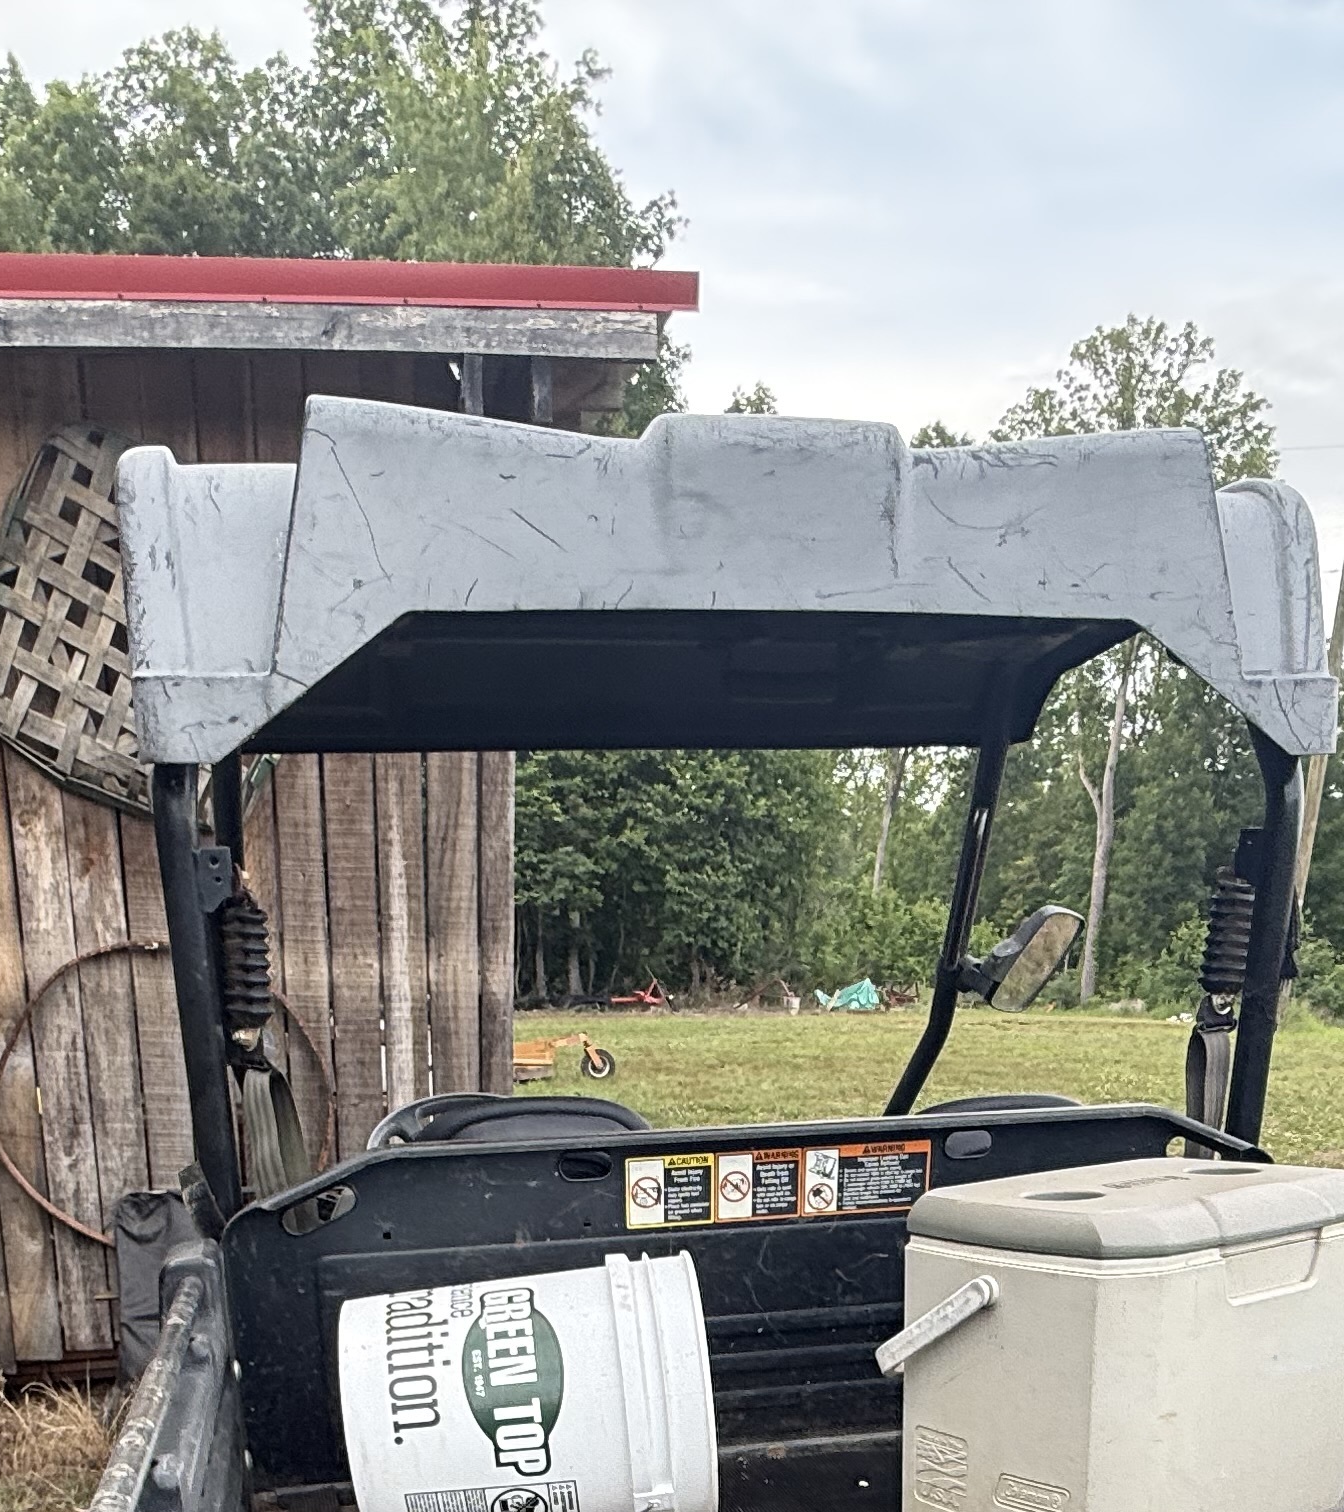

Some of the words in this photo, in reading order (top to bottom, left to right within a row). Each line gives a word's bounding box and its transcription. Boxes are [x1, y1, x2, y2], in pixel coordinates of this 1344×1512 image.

[677, 1156, 709, 1166] CAUTION
[471, 1350, 483, 1372] EST.
[479, 1288, 538, 1387] GREEN
[493, 1397, 549, 1474] TOP
